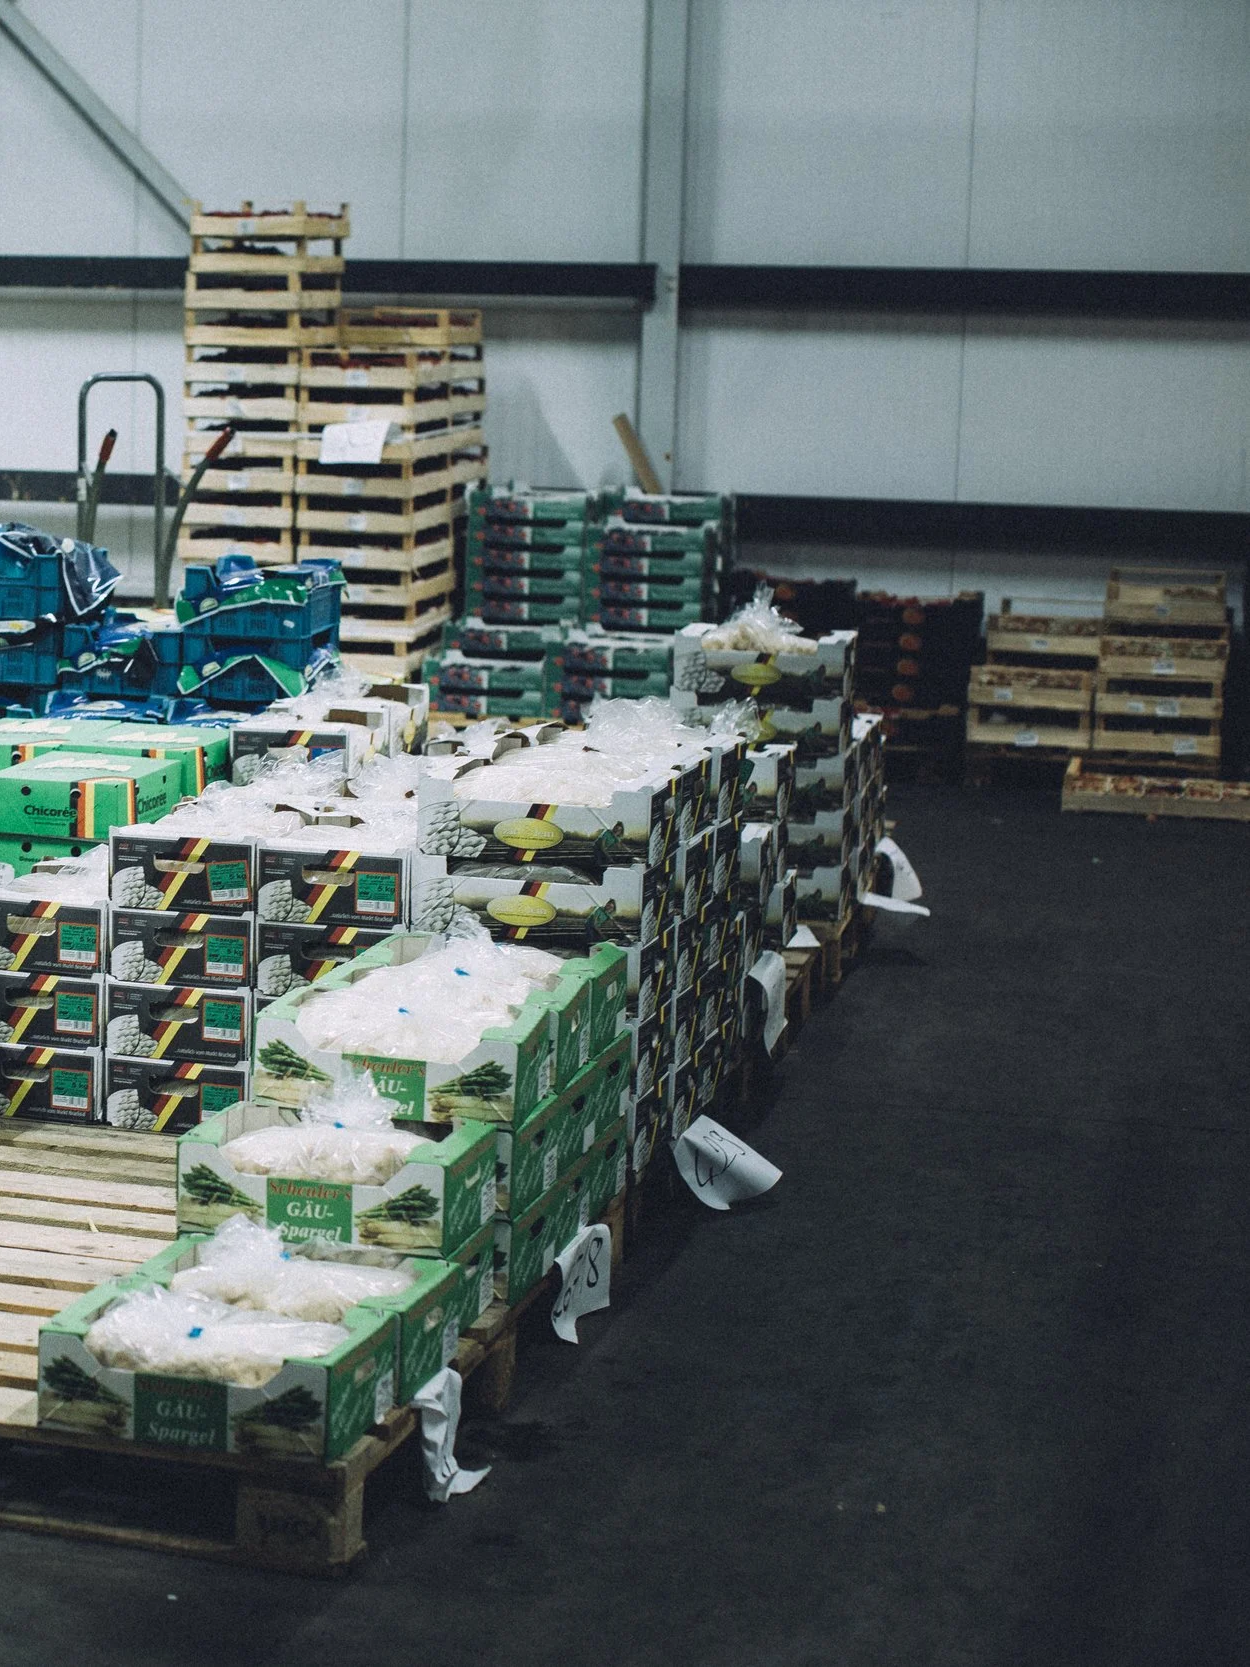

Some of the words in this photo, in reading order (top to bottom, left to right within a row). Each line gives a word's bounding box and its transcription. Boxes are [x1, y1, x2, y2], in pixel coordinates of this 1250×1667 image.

[23, 804, 78, 819] Chicorée
[286, 1200, 334, 1219] GÄU-
[156, 1399, 207, 1420] GÄU-
